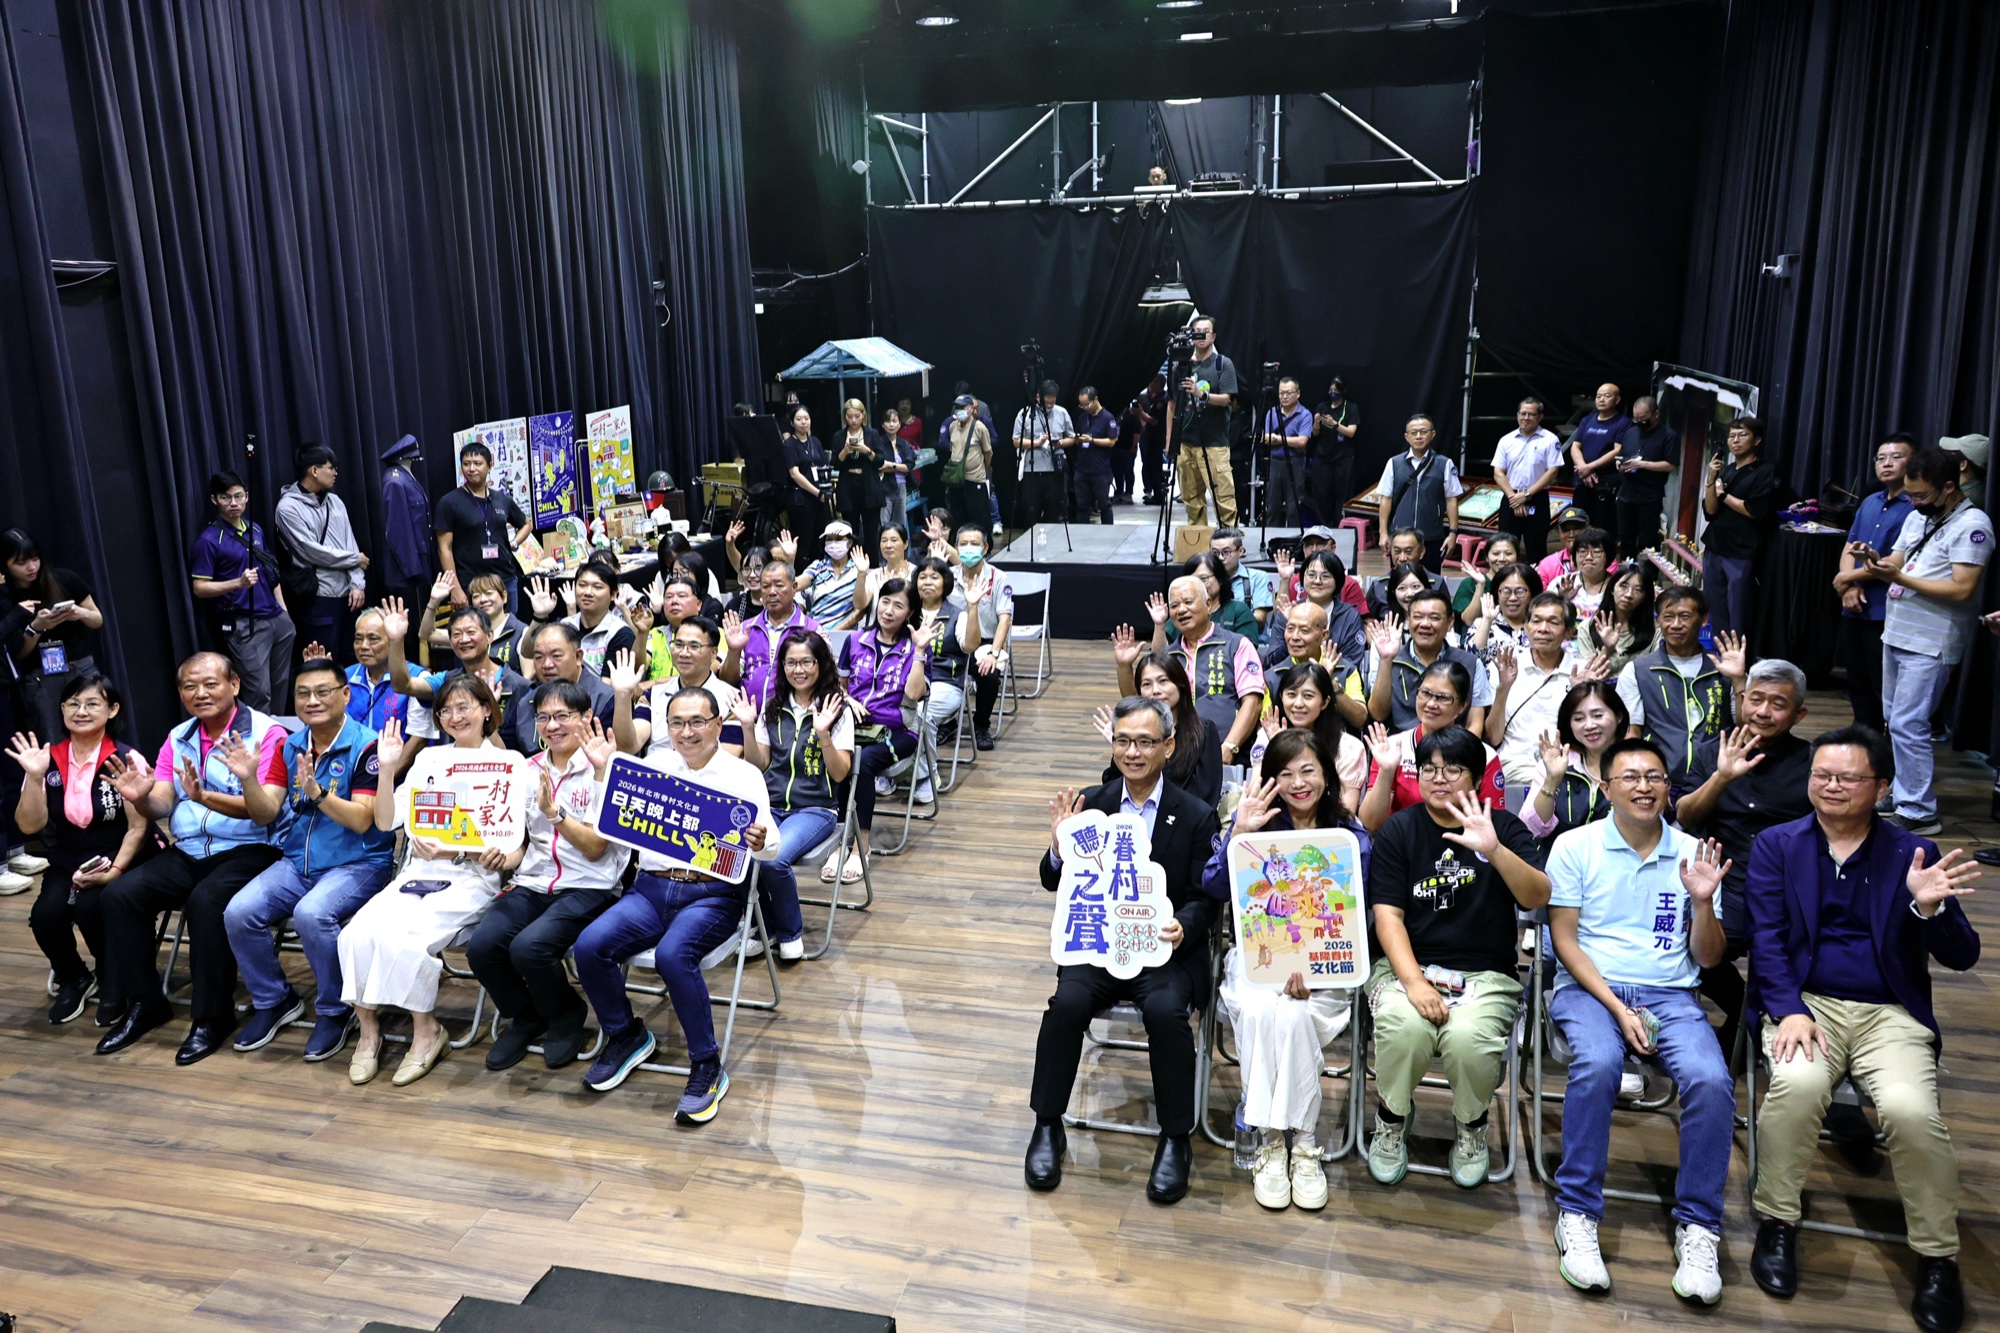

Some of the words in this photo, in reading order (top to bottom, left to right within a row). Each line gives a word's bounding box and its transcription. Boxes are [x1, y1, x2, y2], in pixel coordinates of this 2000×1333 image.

[473, 779, 511, 805] 一村
[617, 780, 637, 793] 2026
[637, 785, 700, 813] 新北市眷村文化節
[459, 801, 513, 826] 一家人
[611, 790, 700, 832] 白天晚上都
[618, 813, 684, 847] CHILL
[1108, 831, 1139, 902] 眷村
[1064, 869, 1110, 954] 之聲
[1120, 907, 1134, 916] ON
[1136, 907, 1151, 916] AIR
[1652, 892, 1677, 951] 王威元
[1309, 951, 1353, 961] 基隆眷村
[1324, 941, 1353, 950] 2026
[1310, 961, 1354, 974] 文化節
